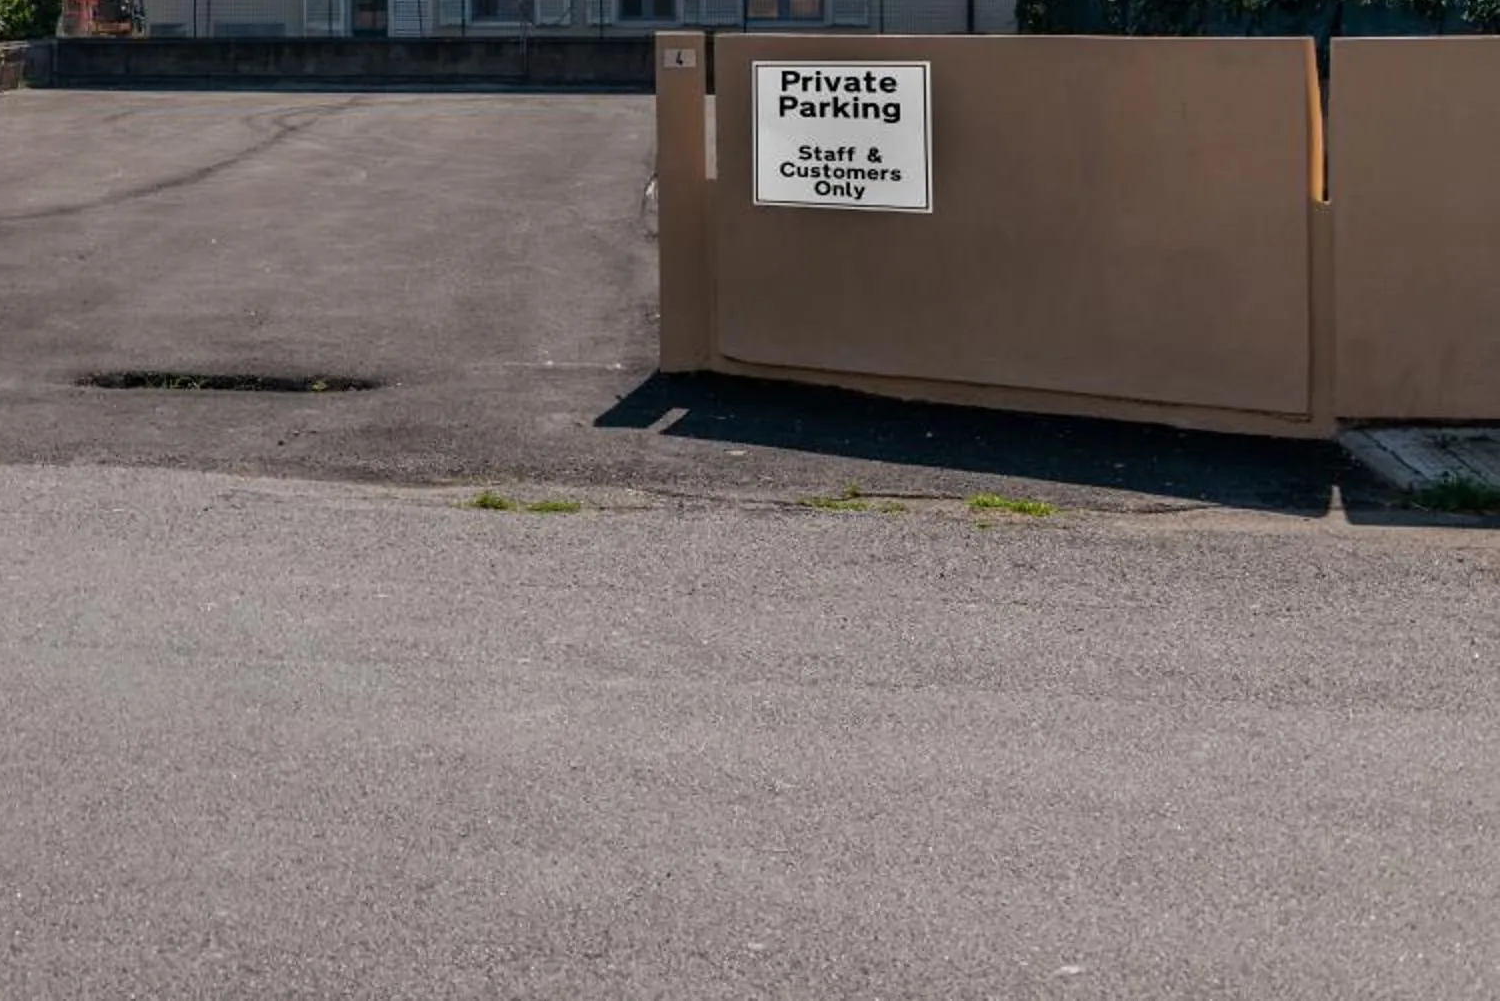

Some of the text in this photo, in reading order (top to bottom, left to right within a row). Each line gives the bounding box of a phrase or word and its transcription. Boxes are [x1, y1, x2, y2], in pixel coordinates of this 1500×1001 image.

[781, 70, 897, 93] Private
[779, 95, 901, 124] Parking
[798, 145, 883, 164] Staff &
[779, 162, 902, 182] Customers
[814, 180, 865, 200] Only
